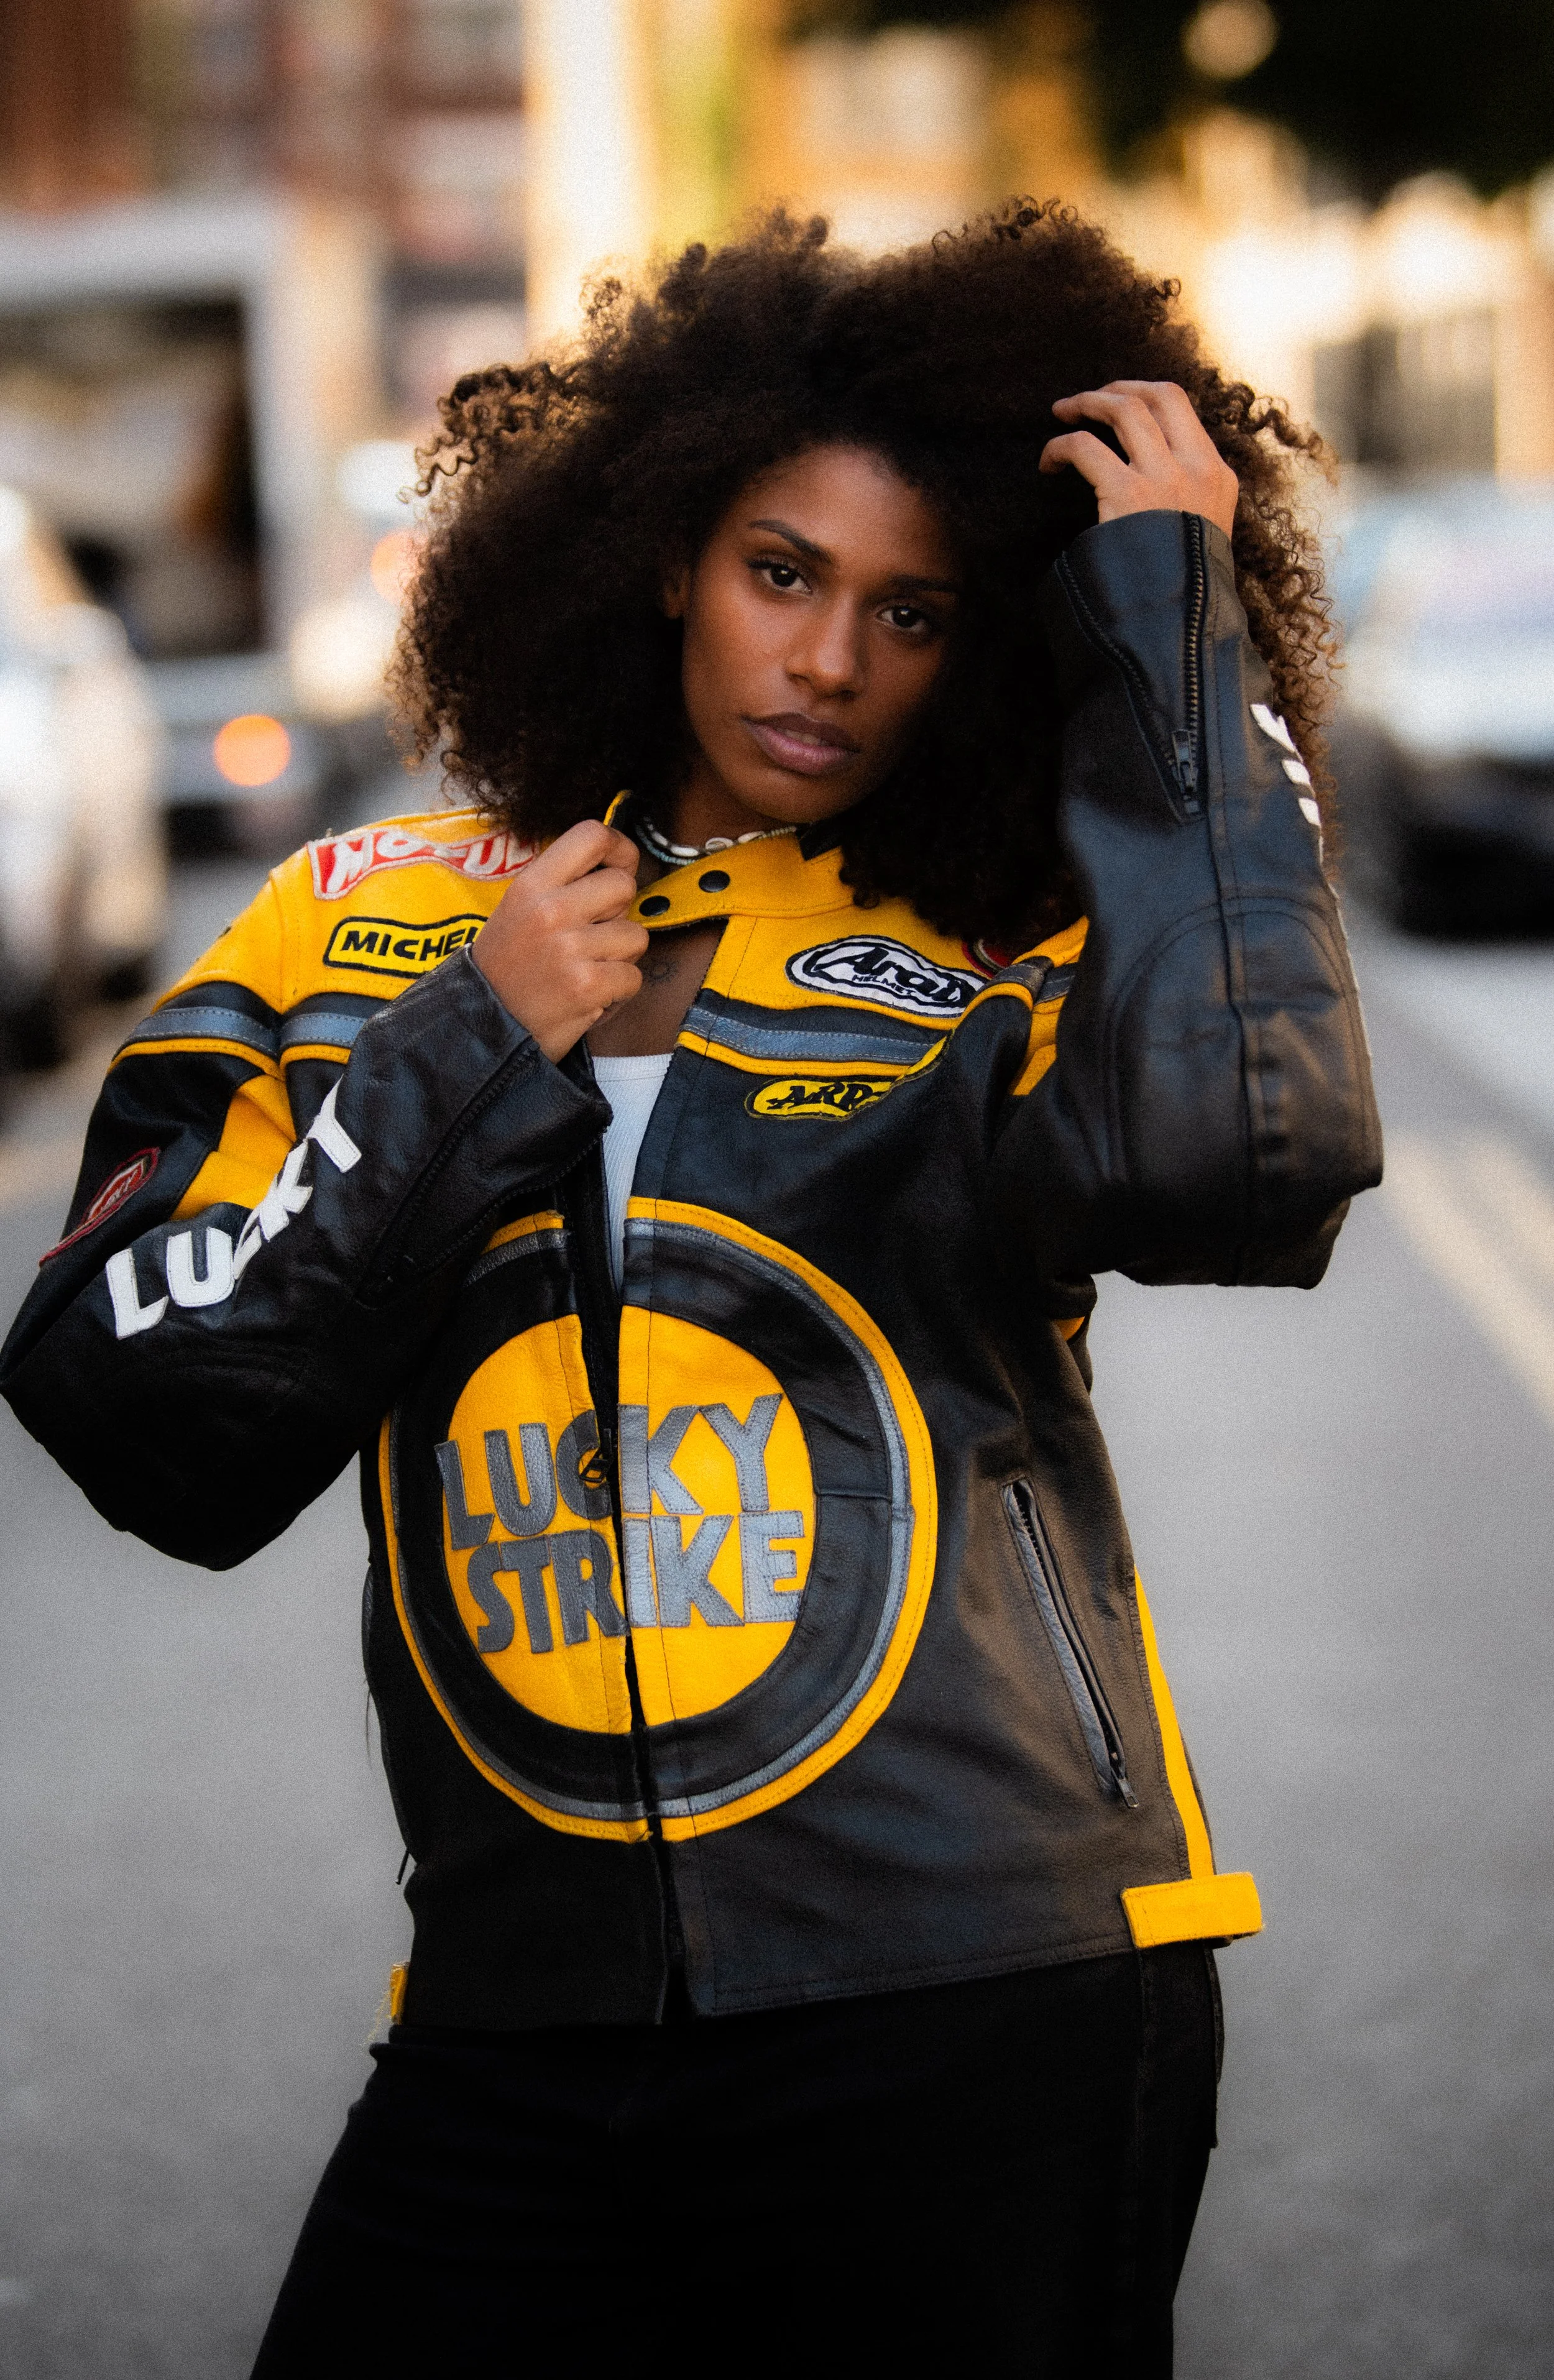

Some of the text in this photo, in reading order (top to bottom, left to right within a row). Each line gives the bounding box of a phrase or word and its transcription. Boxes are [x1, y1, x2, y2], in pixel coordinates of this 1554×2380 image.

[851, 974, 916, 996] HELMET
[434, 1393, 783, 1551] LUCKY
[467, 1510, 804, 1654] STRIKE
